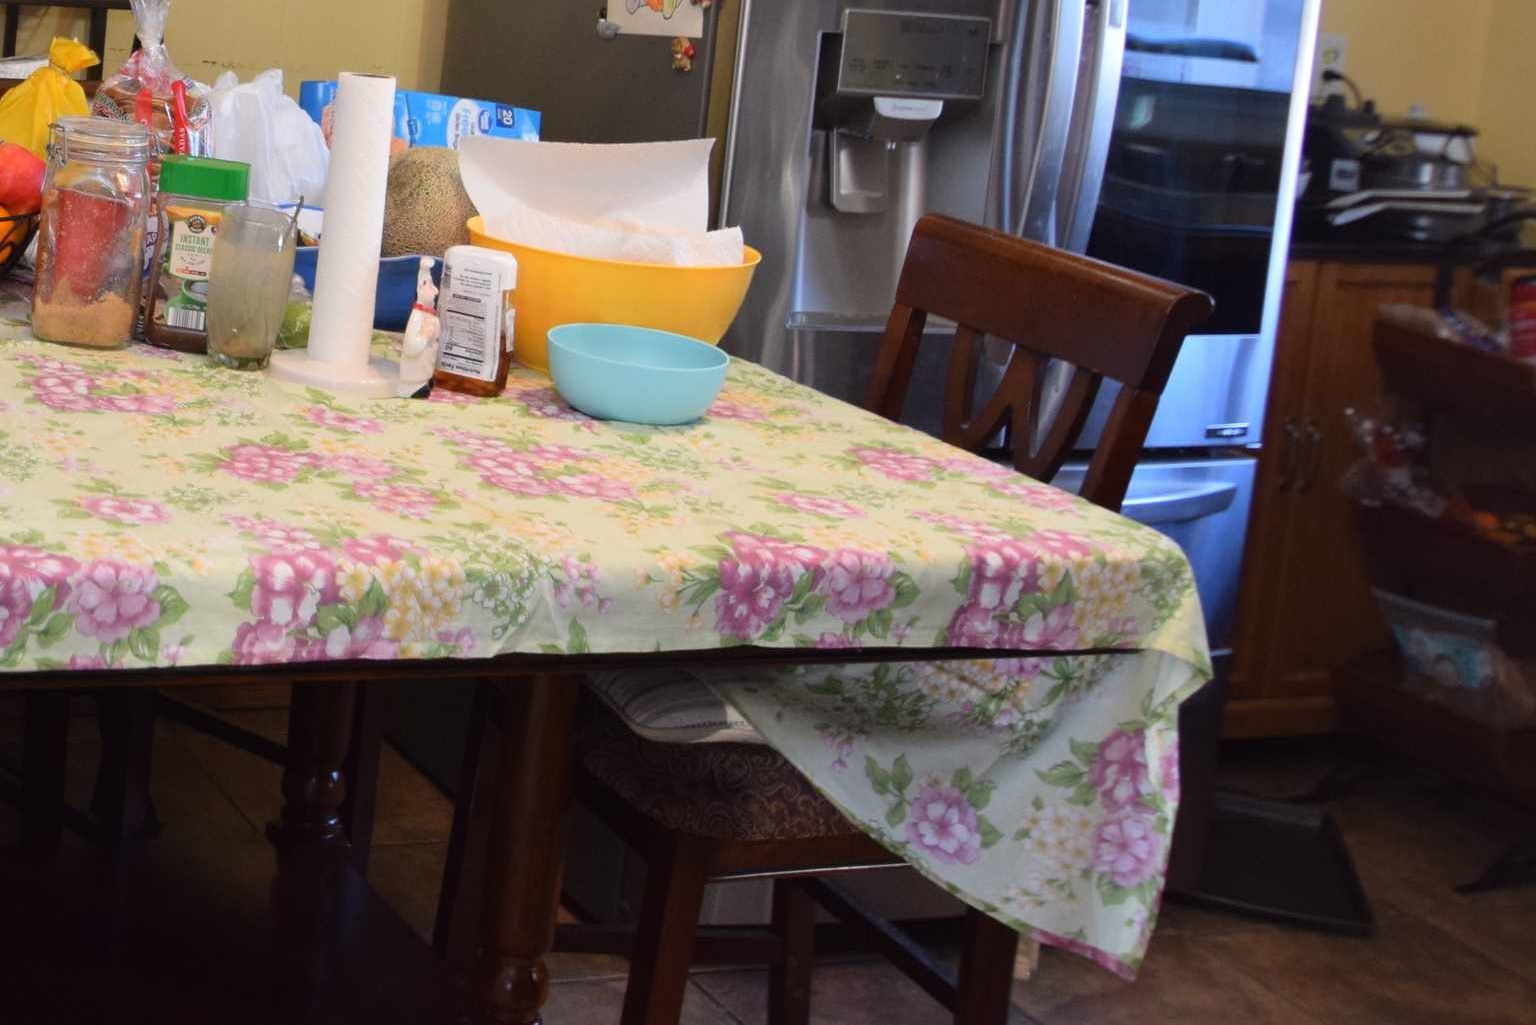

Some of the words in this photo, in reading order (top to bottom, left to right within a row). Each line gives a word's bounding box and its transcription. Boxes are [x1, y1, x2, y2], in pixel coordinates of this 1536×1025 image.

[461, 108, 470, 135] Free
[502, 109, 513, 125] 20
[180, 234, 210, 247] INSTANT
[175, 243, 196, 253] CLASSIC
[441, 361, 454, 370] Facts
[455, 364, 481, 375] Nutrition
